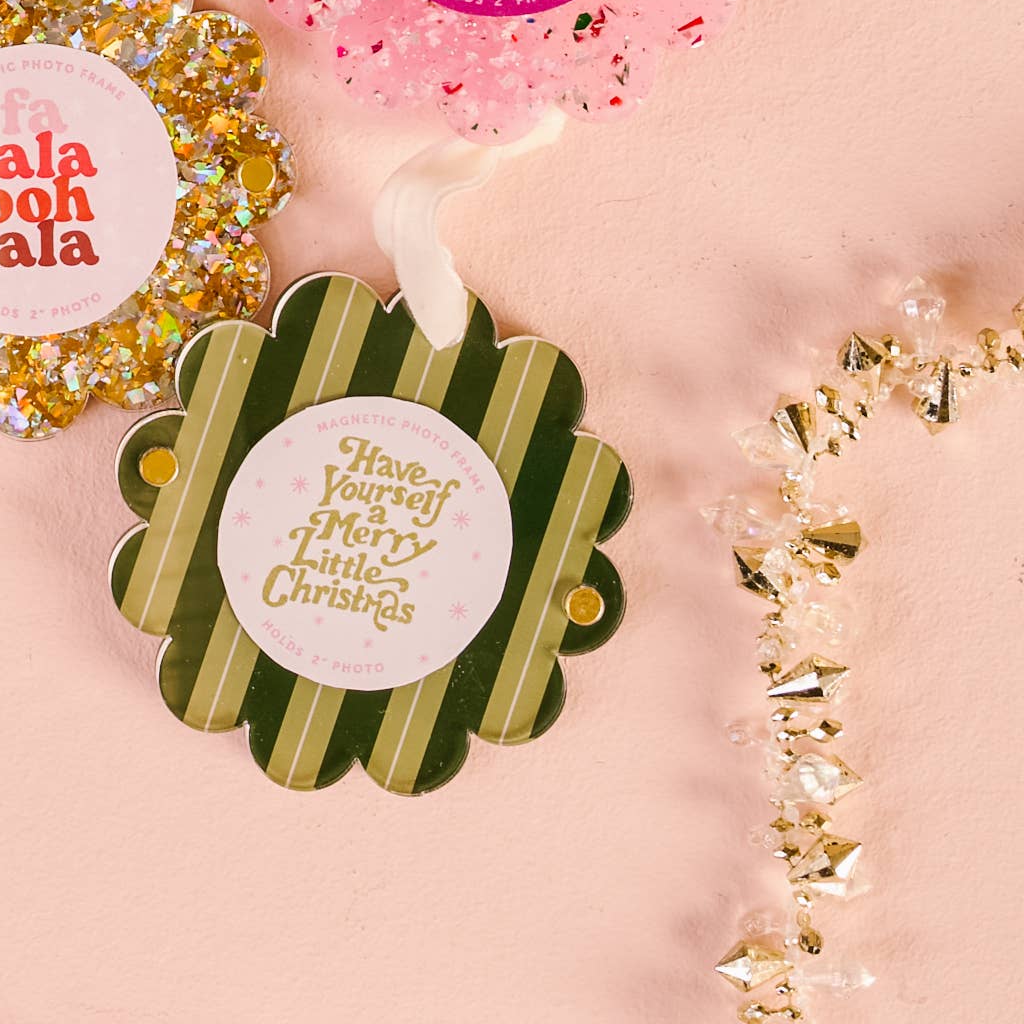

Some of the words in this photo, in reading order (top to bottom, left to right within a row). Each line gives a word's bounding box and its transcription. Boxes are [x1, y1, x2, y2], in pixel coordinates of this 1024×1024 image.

[22, 60, 74, 74] PHOTO
[80, 69, 126, 101] FRAME
[1, 87, 69, 135] fa
[52, 292, 101, 318] PHOTO
[317, 414, 396, 433] MAGNETIC
[401, 420, 449, 450] PHOTO
[451, 451, 486, 494] FRAME
[338, 436, 441, 488] Have
[318, 464, 460, 528] Yourself
[367, 505, 387, 524] a
[288, 526, 409, 592] Little
[309, 510, 438, 567] Merry
[262, 565, 415, 632] Christmas
[262, 619, 304, 657] HOLDS
[332, 662, 384, 673] PHOTO
